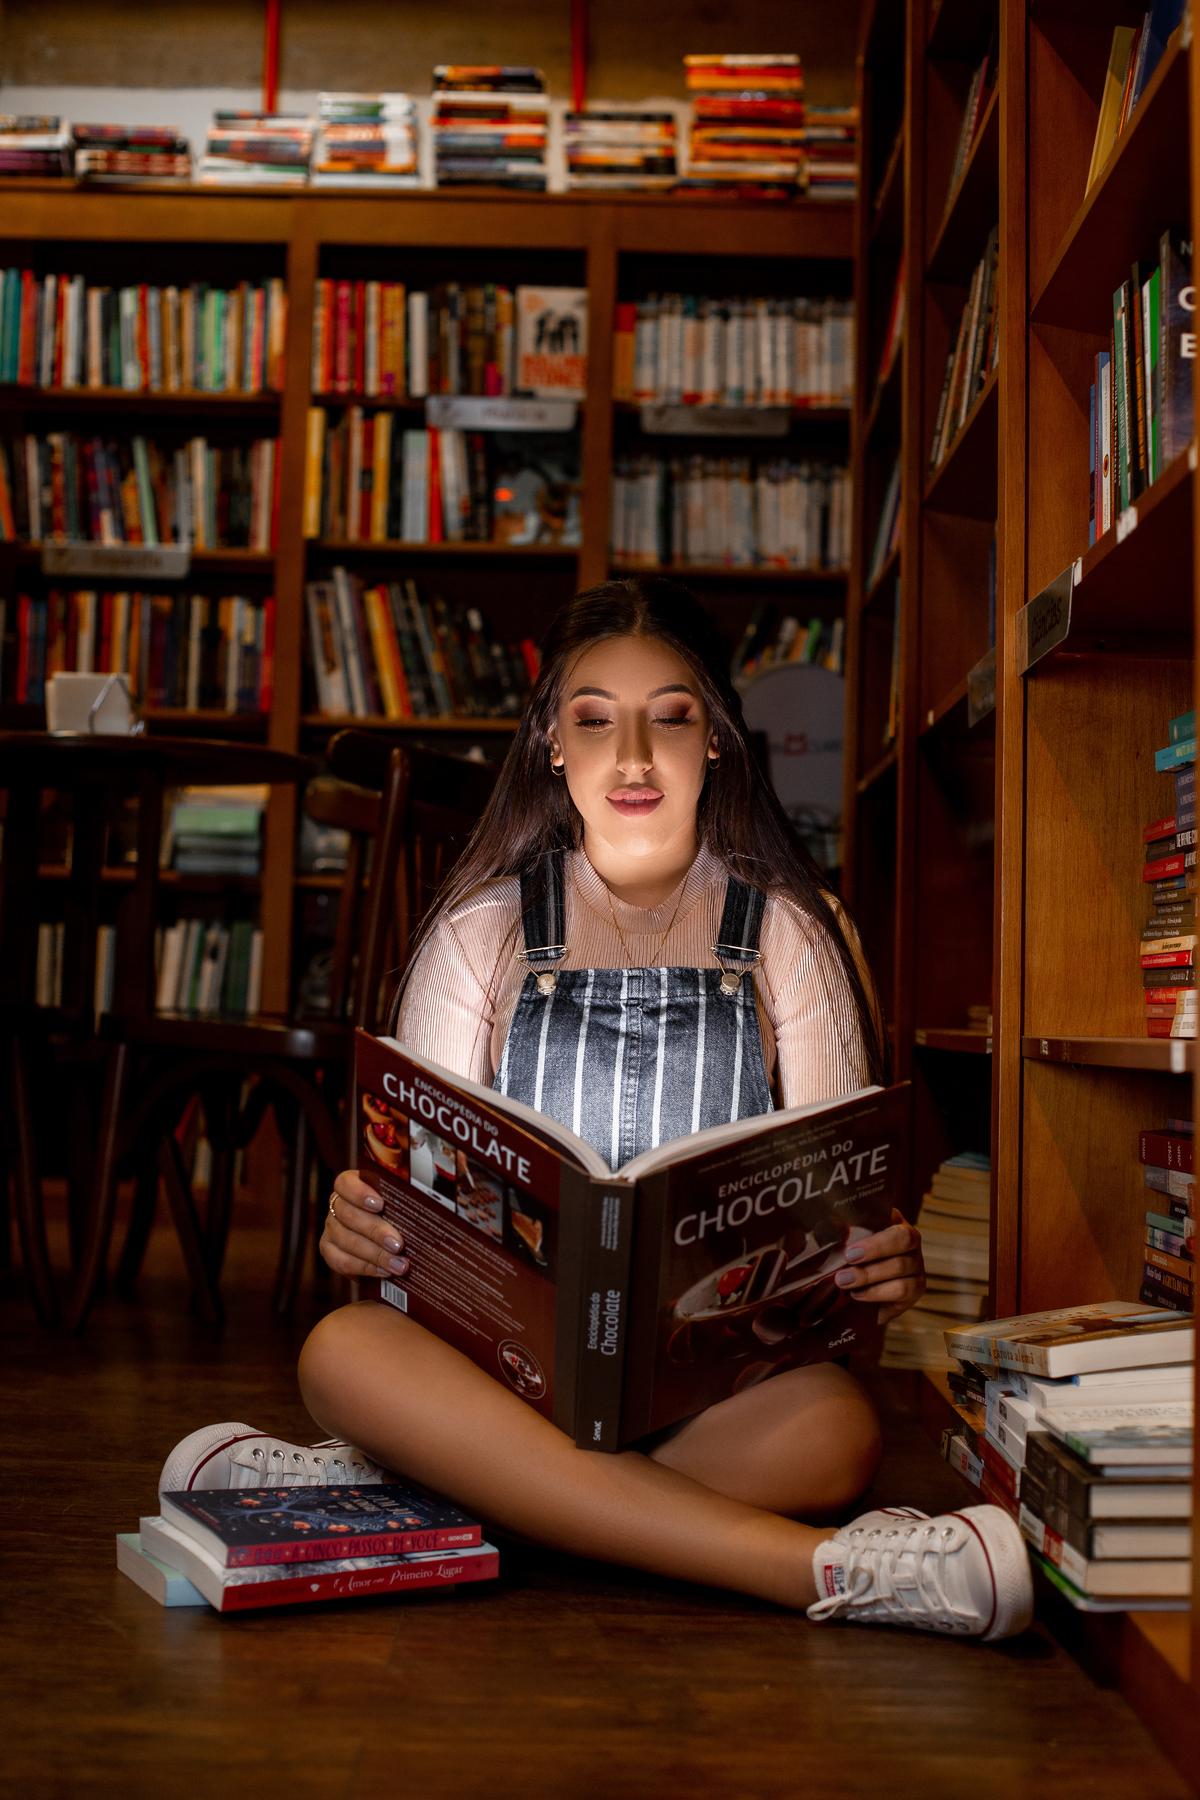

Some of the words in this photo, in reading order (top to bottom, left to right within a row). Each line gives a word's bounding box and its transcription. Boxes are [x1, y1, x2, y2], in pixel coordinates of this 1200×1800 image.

[1031, 596, 1062, 647] Ciências
[382, 1072, 532, 1184] CHOCOLATE
[413, 1076, 484, 1127] ENCICLOPÉDIA
[483, 1121, 499, 1137] DO
[718, 1147, 829, 1199] ENCICLOPÉDIA
[831, 1138, 855, 1158] DO
[673, 1143, 891, 1247] CHOCOLATE
[589, 1292, 601, 1303] do
[600, 1289, 621, 1356] Chocolate
[587, 1301, 601, 1350] Enciclopédia
[1014, 1348, 1035, 1365] alemã
[291, 1546, 301, 1560] A
[304, 1541, 343, 1561] CINCO
[347, 1537, 388, 1556] PASSOS
[392, 1535, 407, 1552] DE
[410, 1530, 439, 1551] VOCÊ
[333, 1577, 372, 1593] Amor
[388, 1569, 434, 1587] Primeiro
[434, 1563, 464, 1580] Lugar
[834, 1565, 845, 1585] STAR
